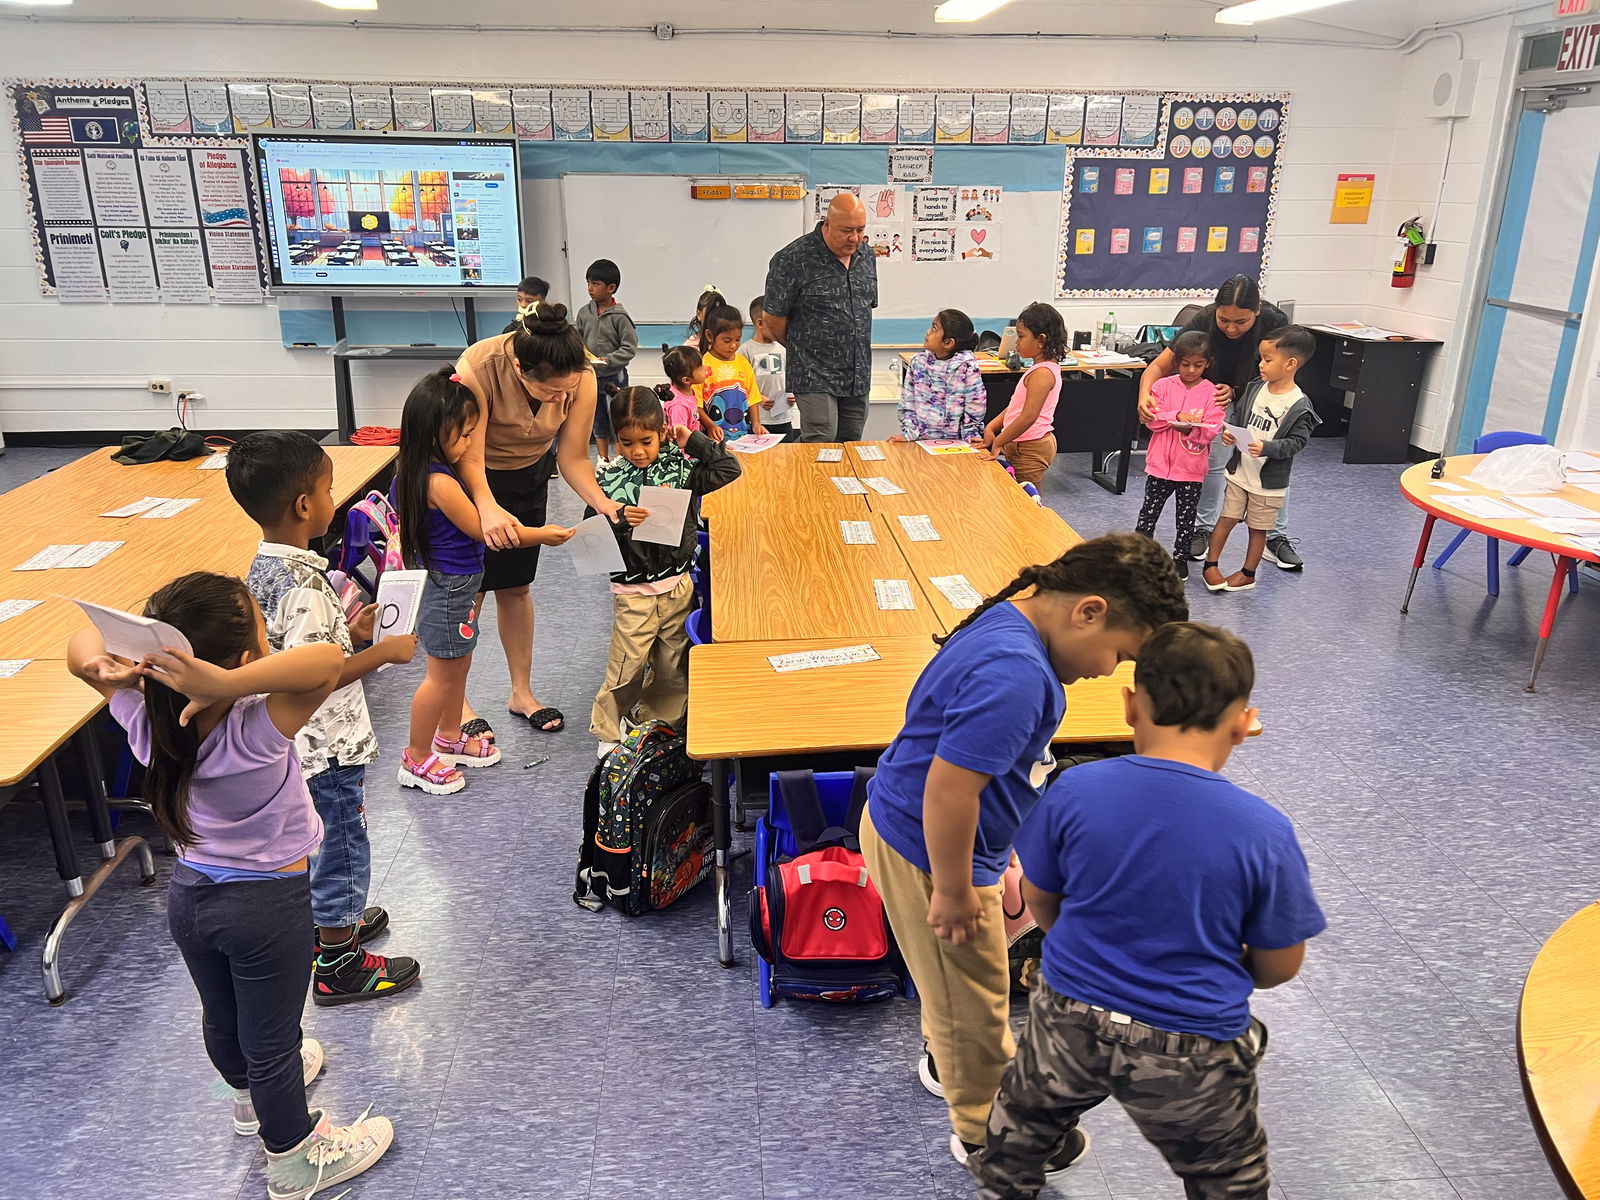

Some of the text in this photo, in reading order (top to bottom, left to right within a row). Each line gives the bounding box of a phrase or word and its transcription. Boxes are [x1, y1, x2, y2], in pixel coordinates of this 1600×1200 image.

[1557, 24, 1600, 71] EXIT
[99, 98, 129, 106] Pledges
[207, 152, 226, 160] Pledge
[207, 161, 237, 169] Allegiance
[741, 189, 762, 197] August
[784, 189, 799, 197] 2025
[100, 230, 147, 240] Colt's Pledge
